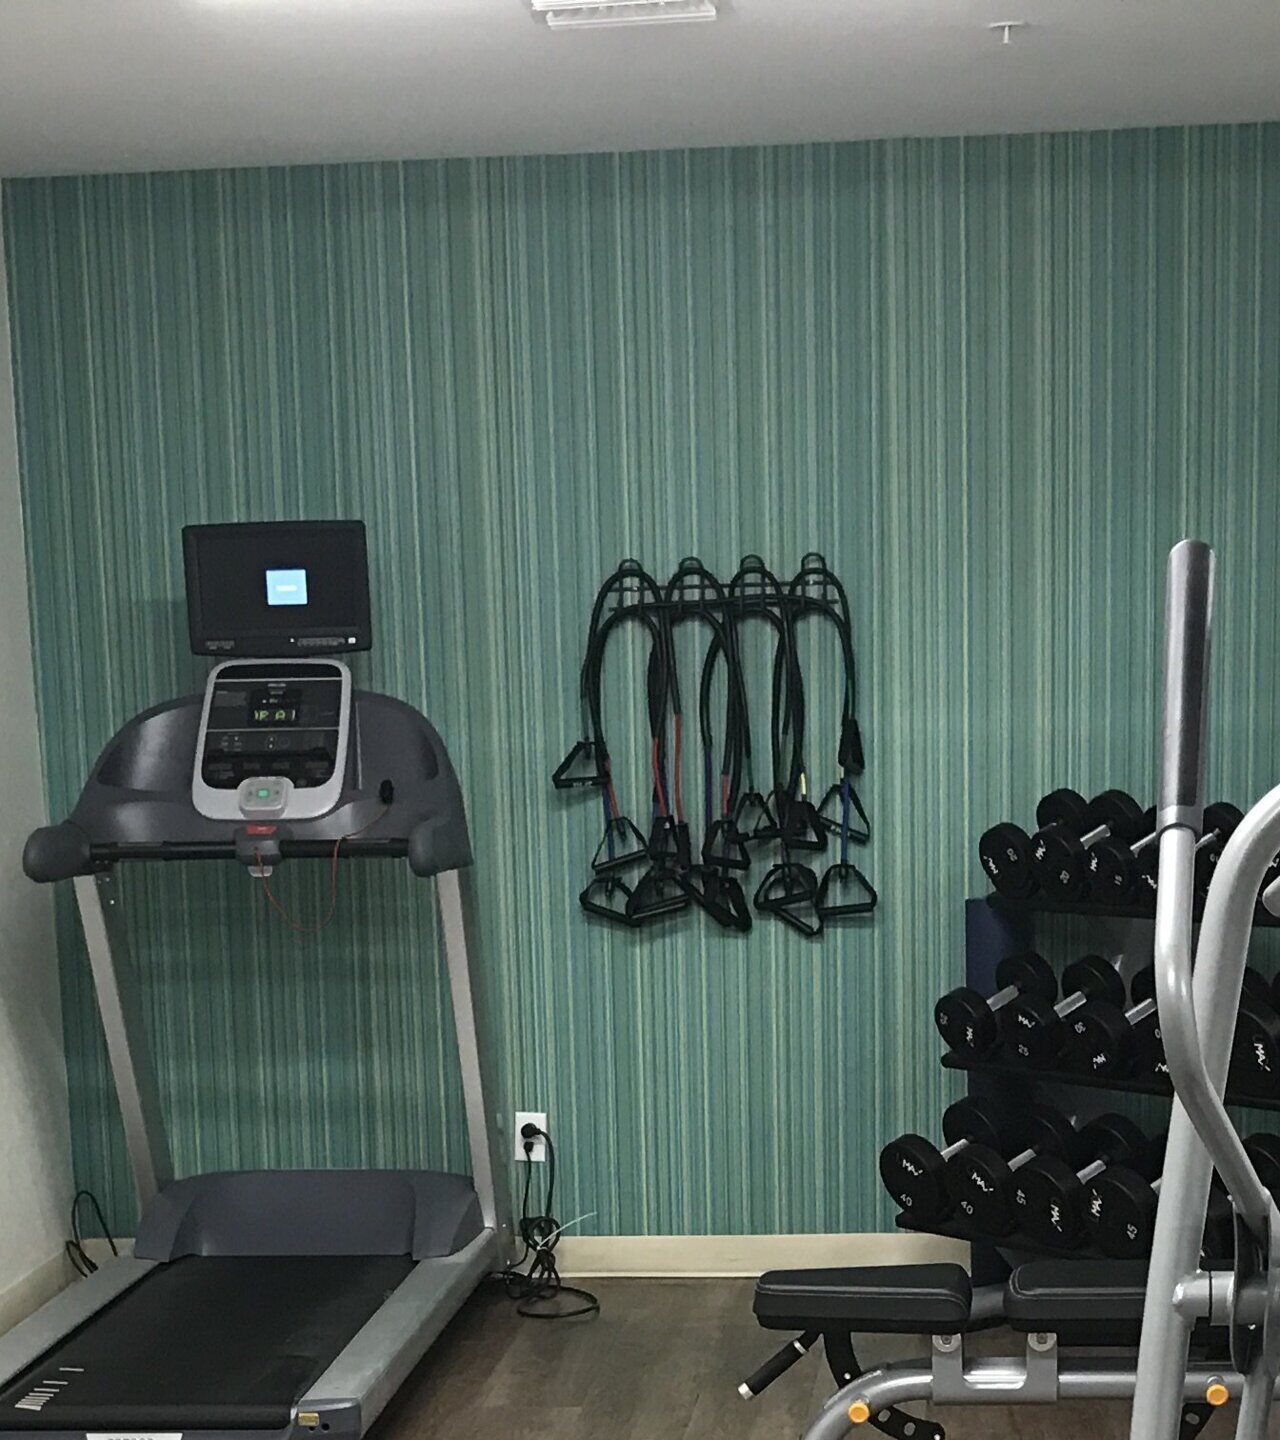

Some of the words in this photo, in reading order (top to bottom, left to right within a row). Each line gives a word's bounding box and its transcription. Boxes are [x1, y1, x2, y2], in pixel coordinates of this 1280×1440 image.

[899, 1193, 913, 1208] 40
[960, 1201, 974, 1216] 40
[1126, 1223, 1138, 1240] 45
